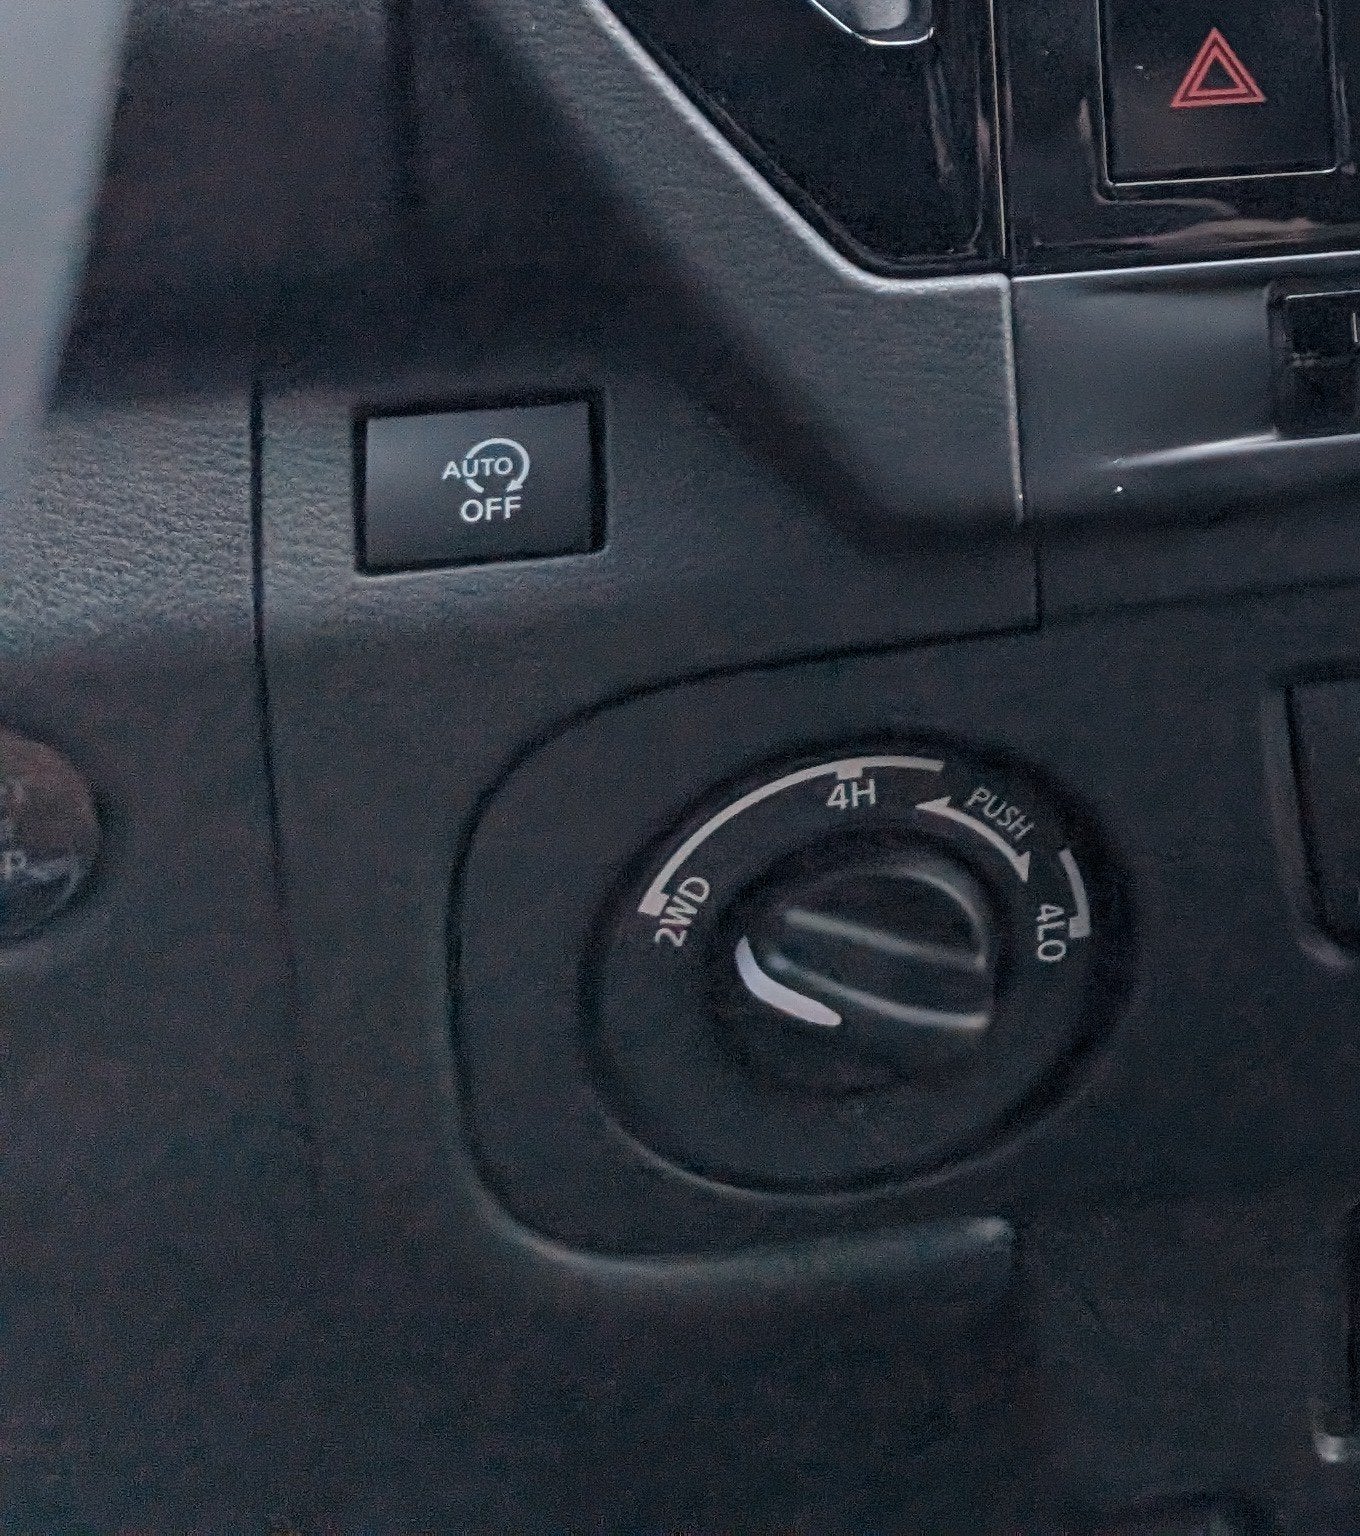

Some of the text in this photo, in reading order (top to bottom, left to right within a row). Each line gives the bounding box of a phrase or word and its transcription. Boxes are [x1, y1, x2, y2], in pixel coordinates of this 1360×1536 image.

[442, 456, 514, 483] AUTO
[459, 495, 522, 523] OFF
[826, 779, 877, 811] 4H
[964, 786, 1034, 840] PUSH
[653, 873, 713, 950] 2WD
[1033, 901, 1066, 964] 4LO
